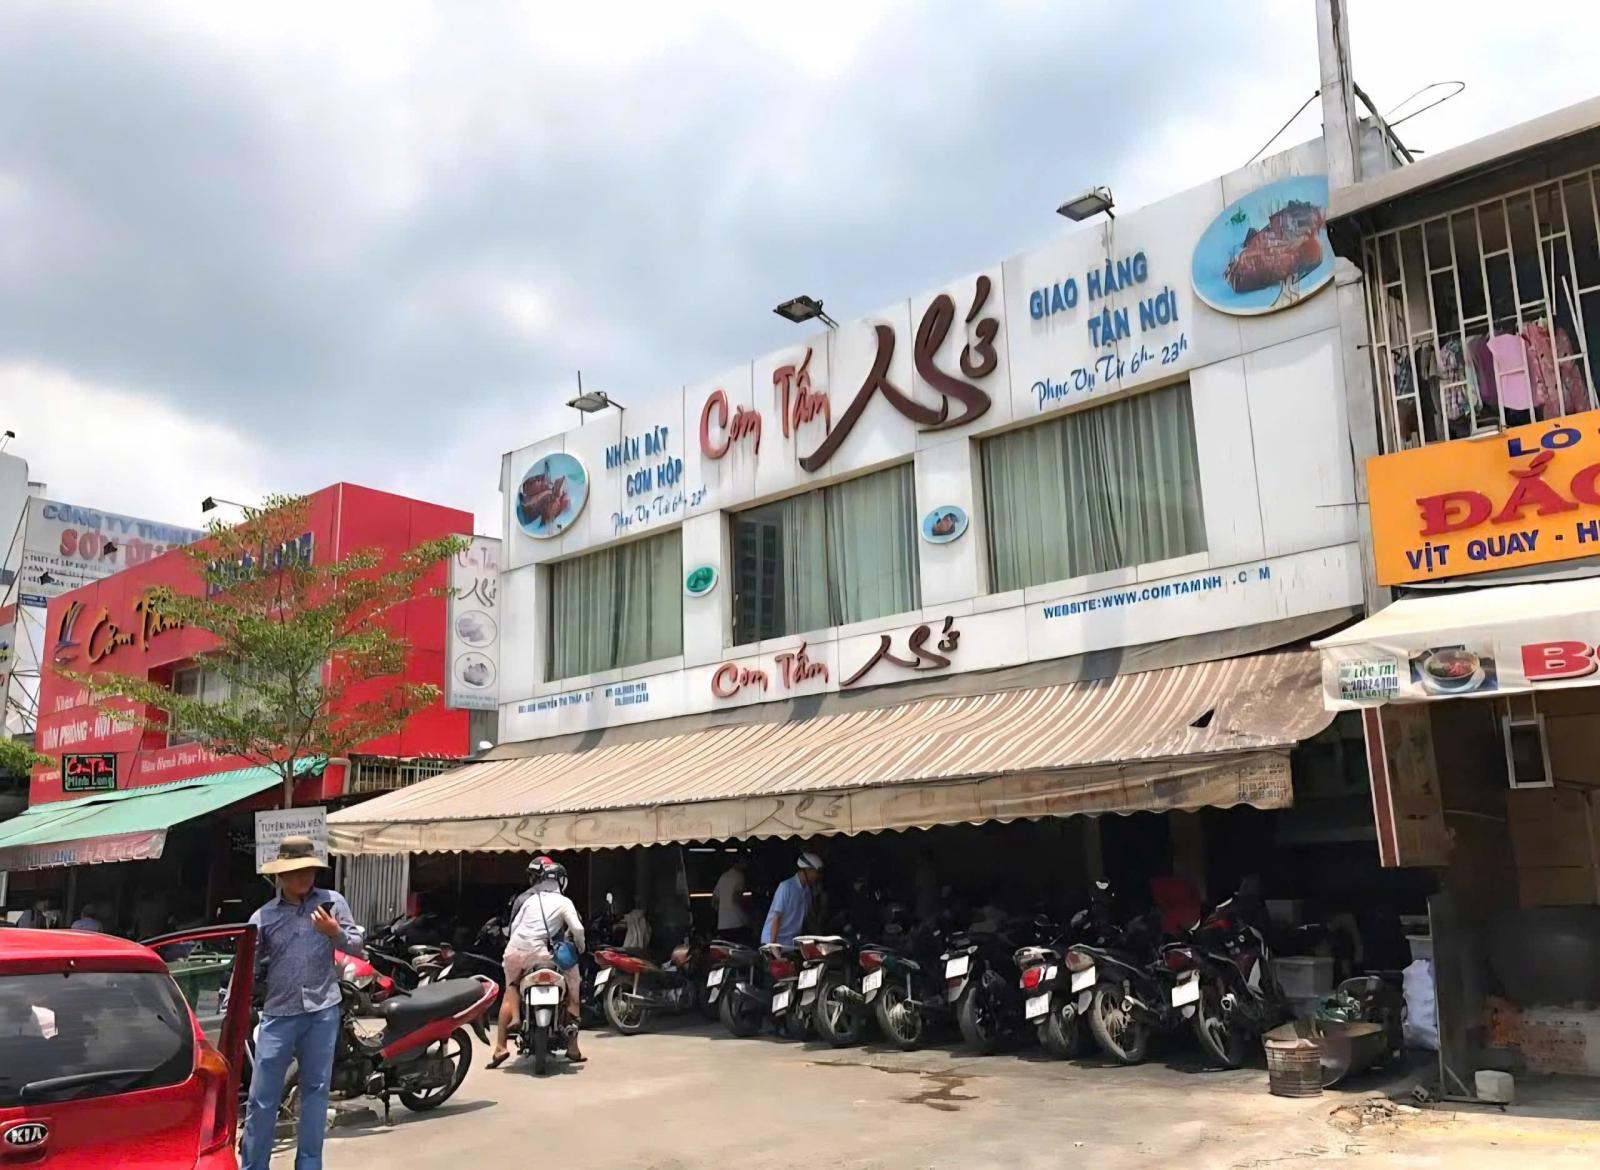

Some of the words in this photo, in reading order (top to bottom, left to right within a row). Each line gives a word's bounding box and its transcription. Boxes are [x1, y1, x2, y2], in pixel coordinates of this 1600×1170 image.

[1029, 278, 1078, 320] GIAO
[1087, 252, 1148, 301] HÀNG
[1088, 304, 1131, 348] TẬN
[1139, 286, 1179, 331] NƠI
[700, 389, 762, 459] Cơm
[773, 347, 831, 439] Tấm
[606, 435, 640, 469] NHẬN
[1508, 424, 1582, 458] LÒ
[626, 467, 652, 497] CƠM
[657, 456, 683, 488] HỘP
[1405, 541, 1450, 572] VỊT
[1467, 529, 1539, 561] QUAY
[711, 662, 768, 698] Cơm
[775, 642, 829, 689] Tấm
[11, 1127, 42, 1143] KIA
